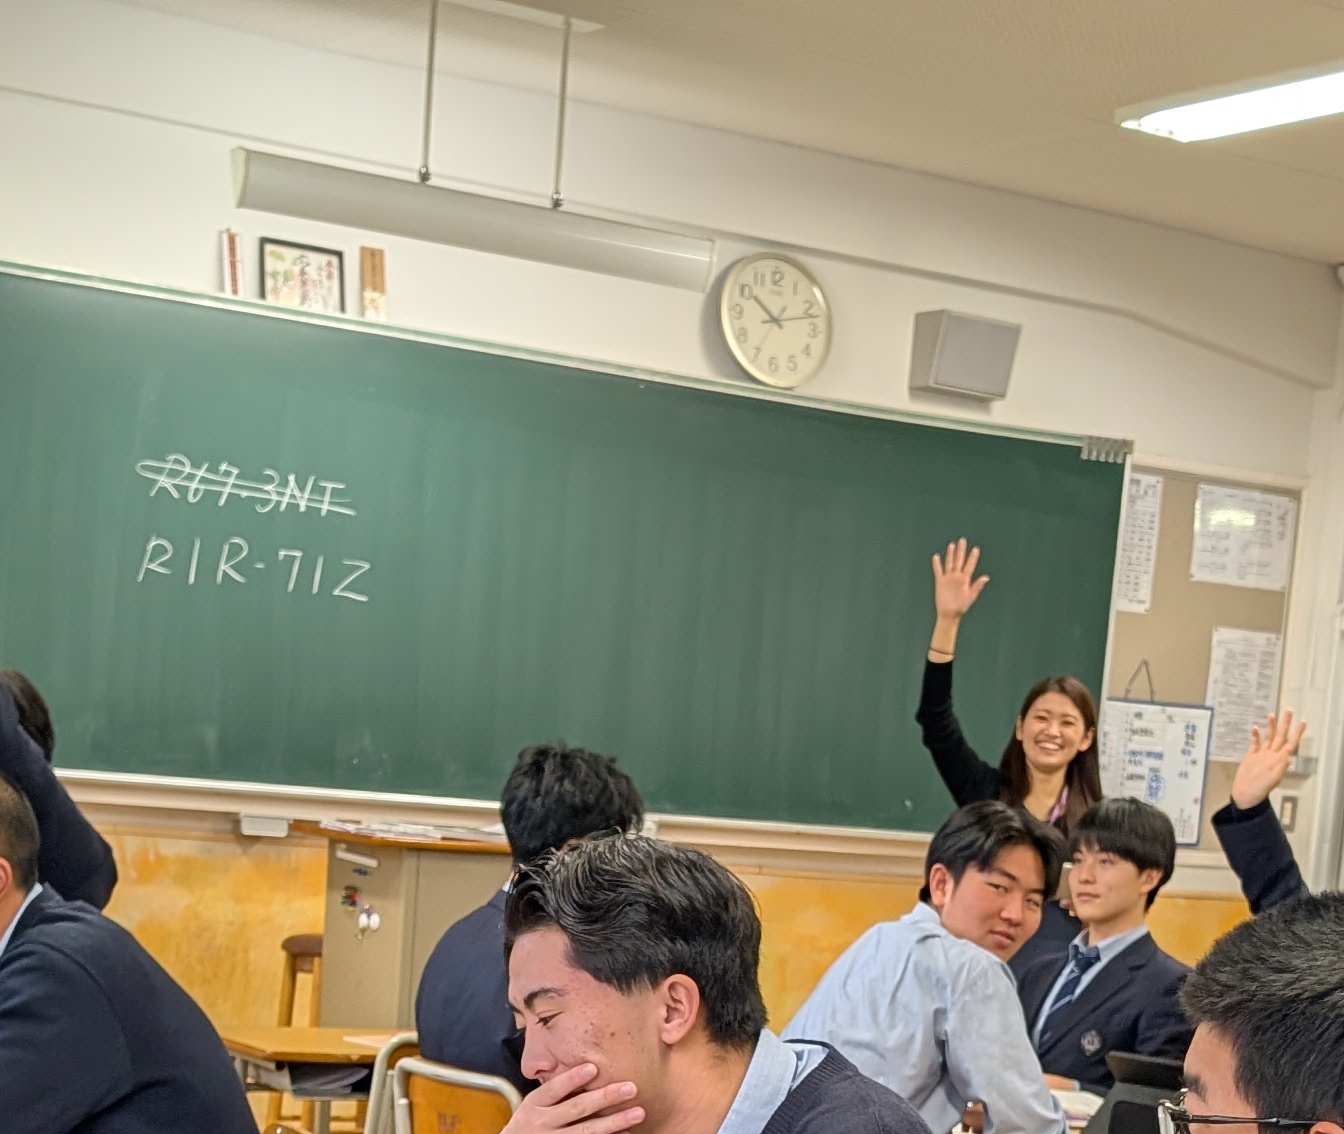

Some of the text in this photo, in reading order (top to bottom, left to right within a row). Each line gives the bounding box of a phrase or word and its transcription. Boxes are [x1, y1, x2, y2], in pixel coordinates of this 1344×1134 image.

[807, 322, 819, 339] 3
[768, 356, 780, 372] 6
[787, 355, 798, 371] 5
